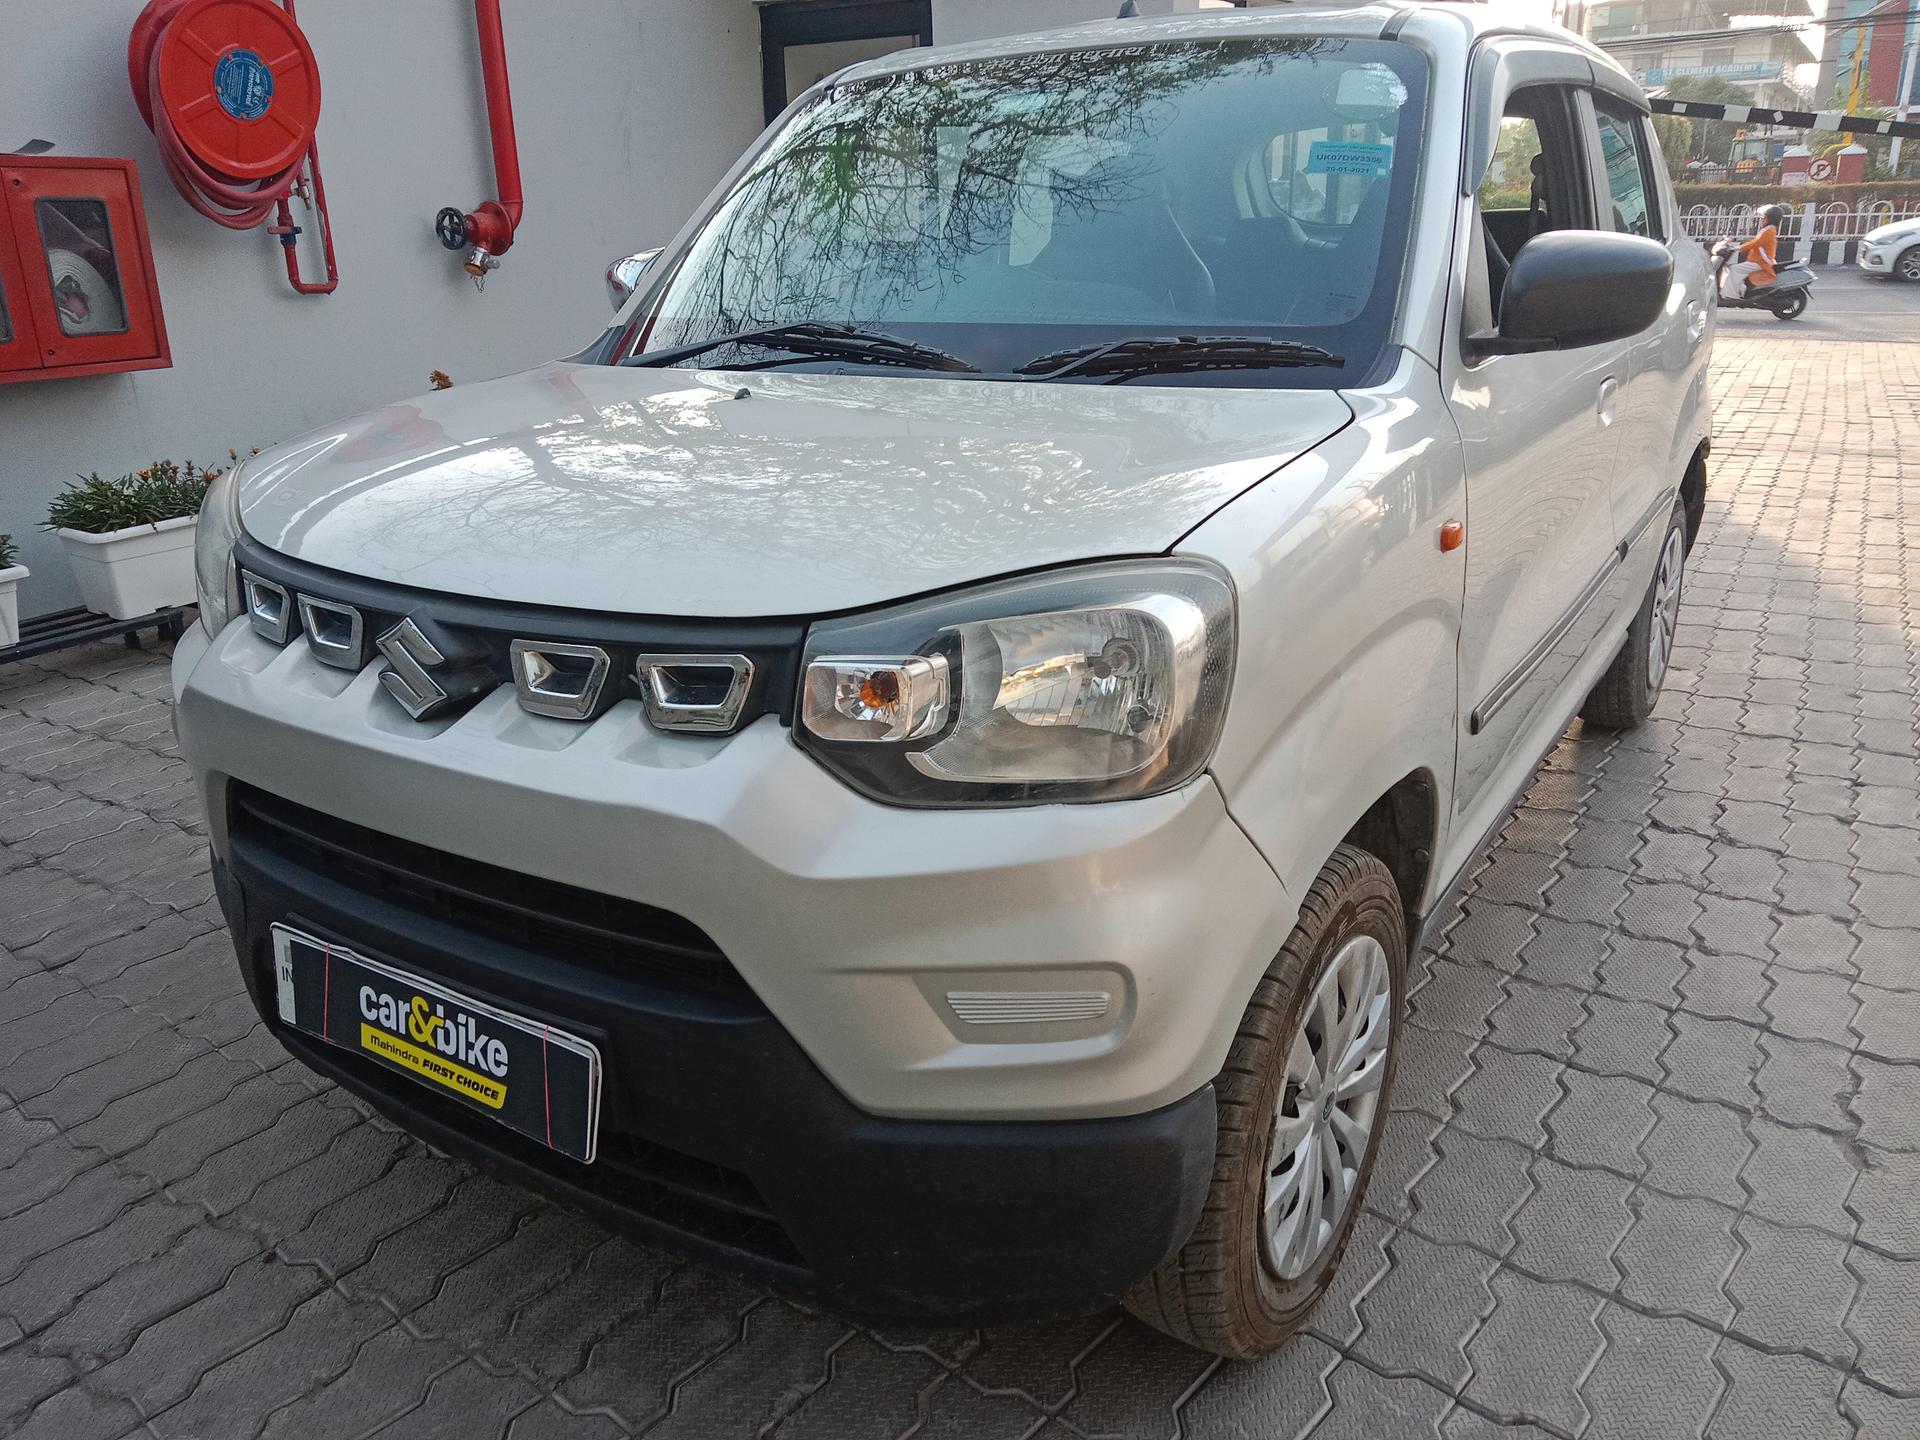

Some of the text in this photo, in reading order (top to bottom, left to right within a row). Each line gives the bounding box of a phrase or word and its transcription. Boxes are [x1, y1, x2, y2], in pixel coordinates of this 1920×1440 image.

[1715, 63, 1758, 74] ACADEMY
[371, 1034, 499, 1101] Mahindra FIRST CHOICE
